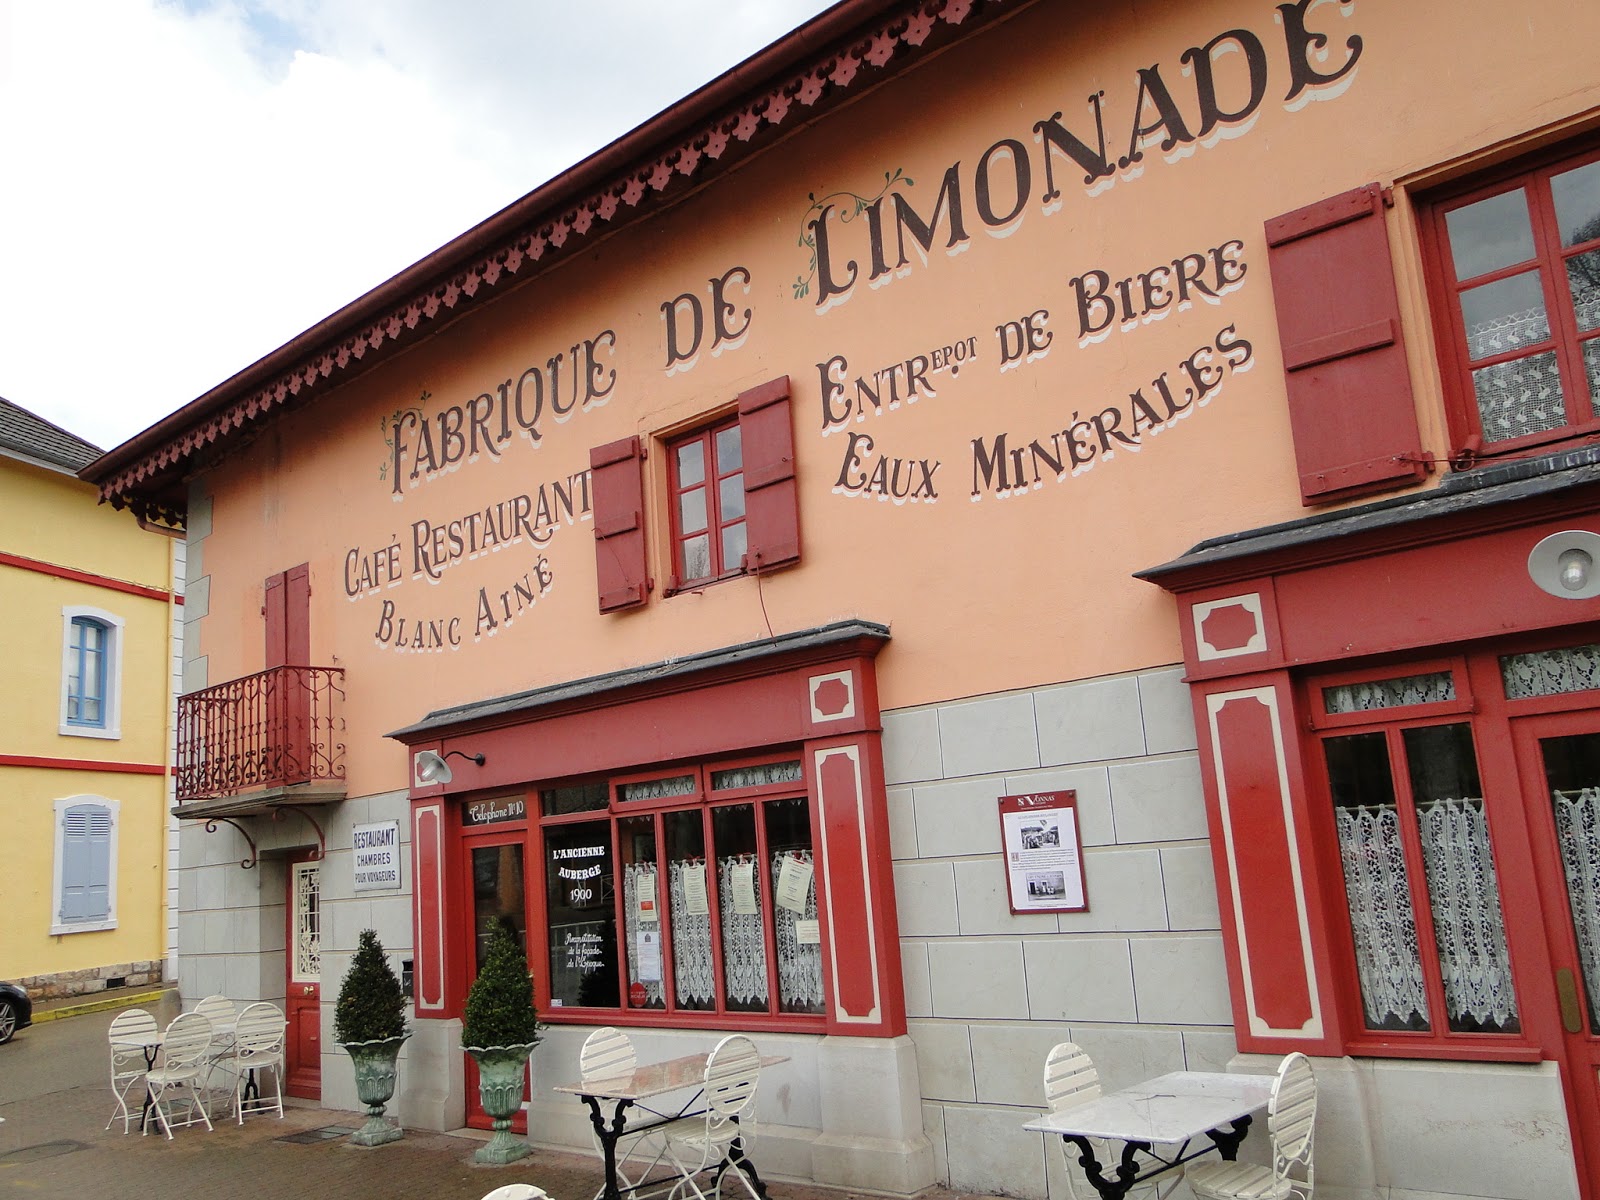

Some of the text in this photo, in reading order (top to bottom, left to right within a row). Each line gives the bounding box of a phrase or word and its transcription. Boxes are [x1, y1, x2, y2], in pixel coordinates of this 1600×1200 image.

[390, 0, 1363, 497] FABRIQUE DE LIMONADE
[995, 310, 1054, 369] DE
[1069, 239, 1248, 344] BIERE
[833, 324, 1253, 502] EAUX MINÉRALES
[344, 469, 592, 599] CAFÉ RESTAURANT
[375, 553, 553, 651] BLANC AINÉ
[354, 828, 395, 849] RESTAURANT
[357, 852, 391, 867] CHAMBRES
[553, 846, 605, 860] L'ANCIENNE
[355, 870, 396, 883] POUR VOYAGEURS
[558, 864, 602, 880] AUBERGE
[570, 888, 593, 903] 1900
